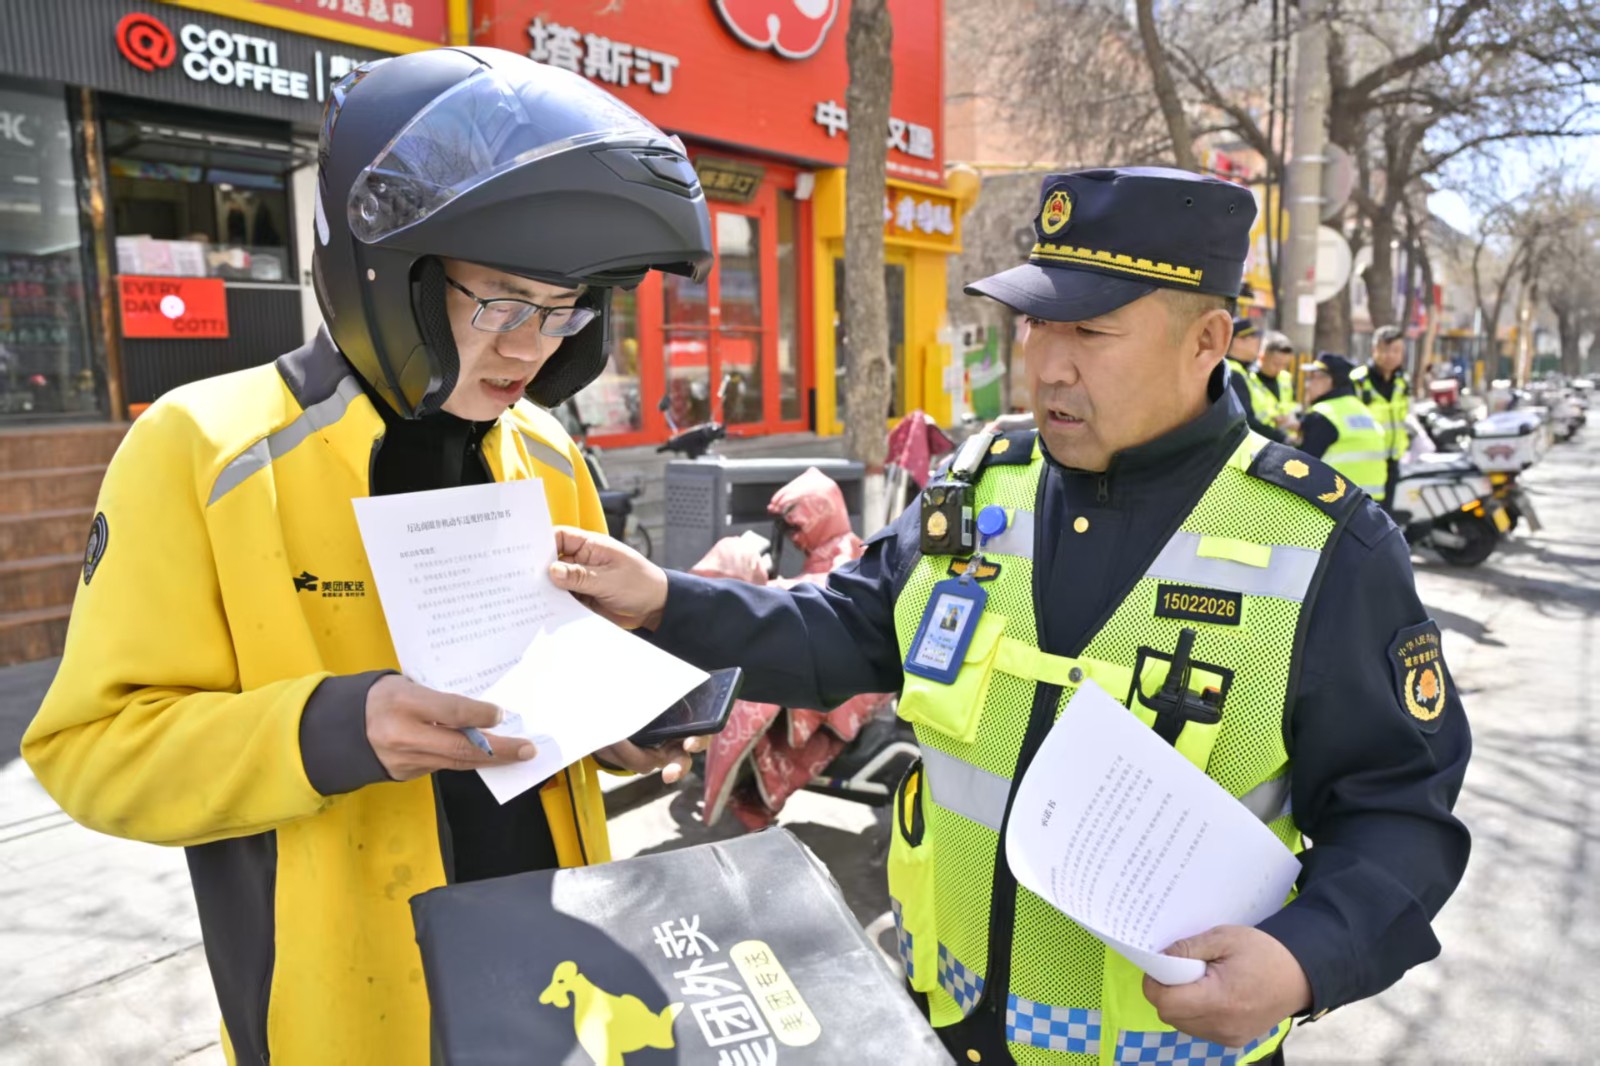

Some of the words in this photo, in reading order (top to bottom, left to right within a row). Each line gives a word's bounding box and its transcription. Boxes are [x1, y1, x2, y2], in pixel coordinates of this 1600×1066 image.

[180, 24, 278, 67] COTTI
[528, 16, 680, 94] 塔斯汀
[182, 52, 309, 99] COFFEE
[123, 282, 182, 296] EVERY
[173, 319, 226, 333] COTTI
[321, 581, 365, 592] 美团配送
[1163, 592, 1236, 617] 15022026
[745, 950, 811, 1033] 美团专送
